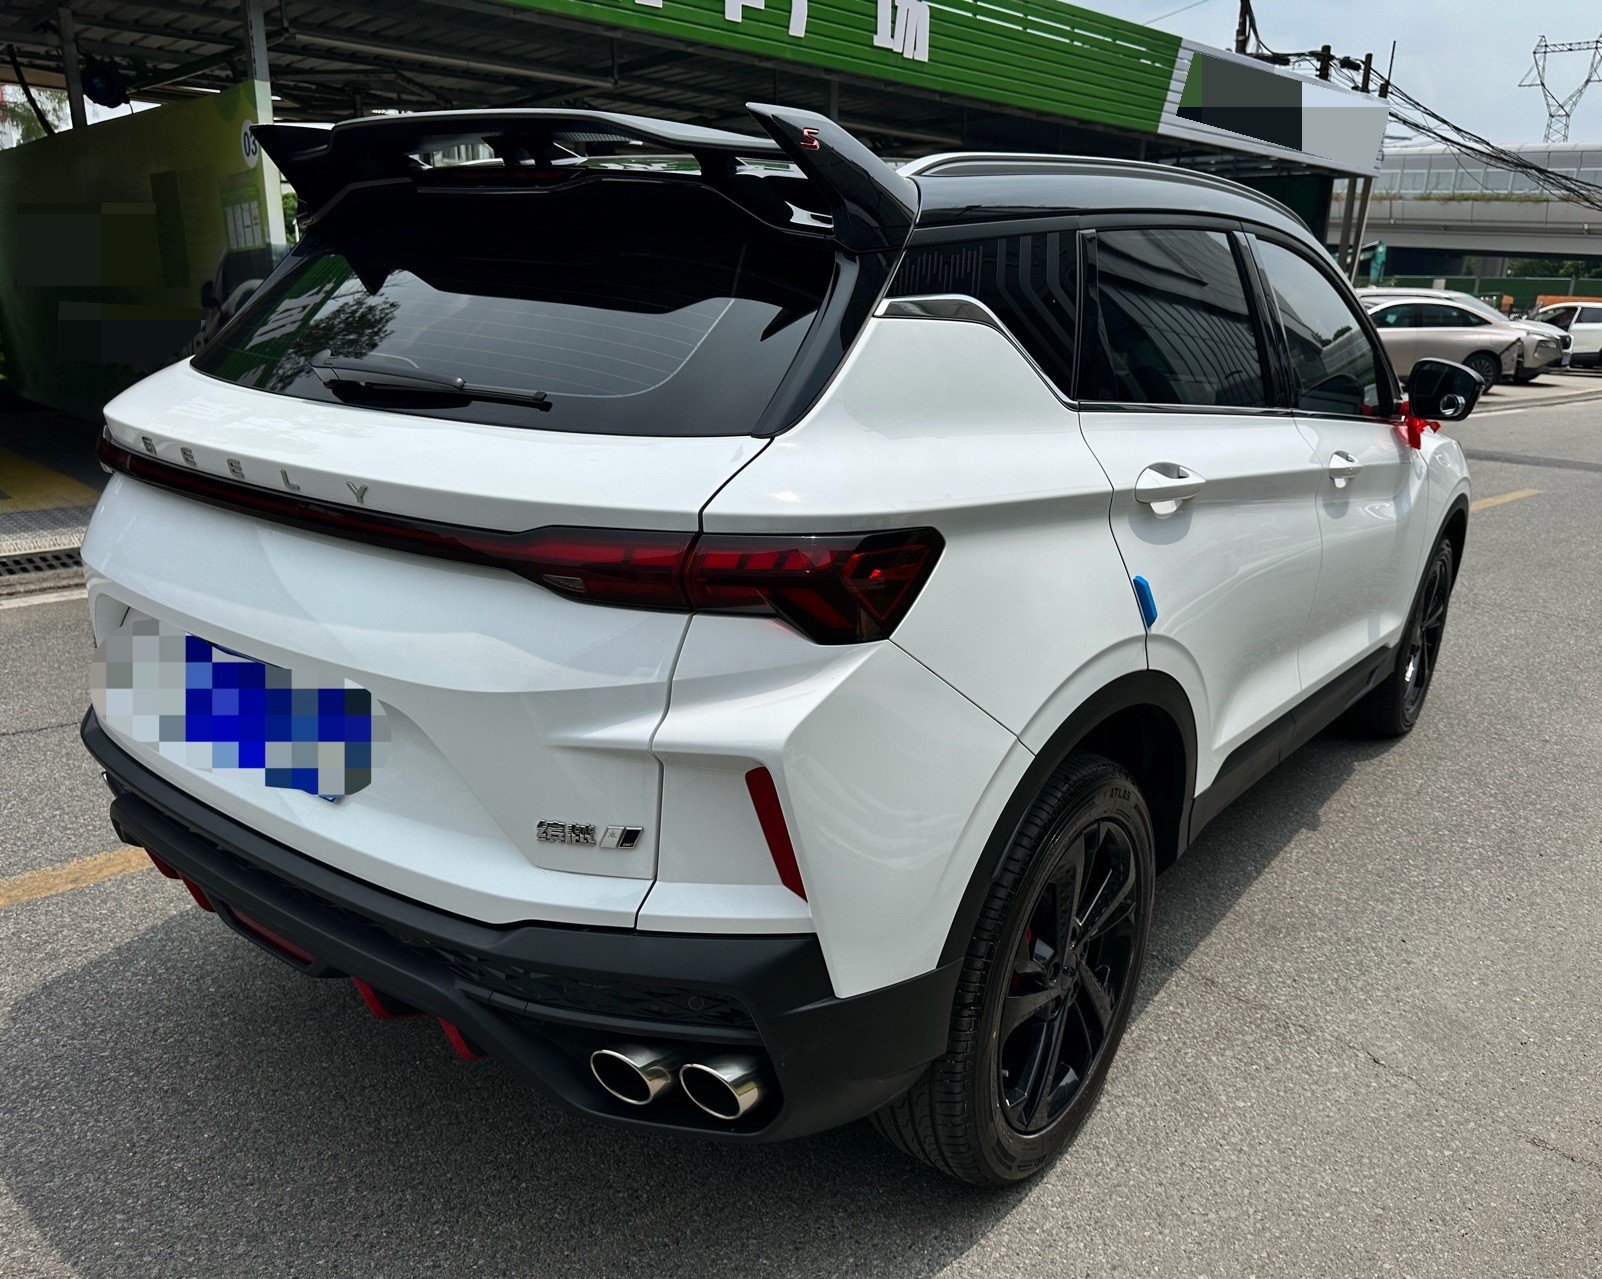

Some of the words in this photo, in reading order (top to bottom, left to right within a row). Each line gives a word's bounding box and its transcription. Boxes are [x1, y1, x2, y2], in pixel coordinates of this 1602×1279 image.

[243, 131, 258, 157] 03
[800, 127, 820, 150] S
[141, 436, 368, 503] GEELY
[1109, 787, 1132, 801] ATLAS
